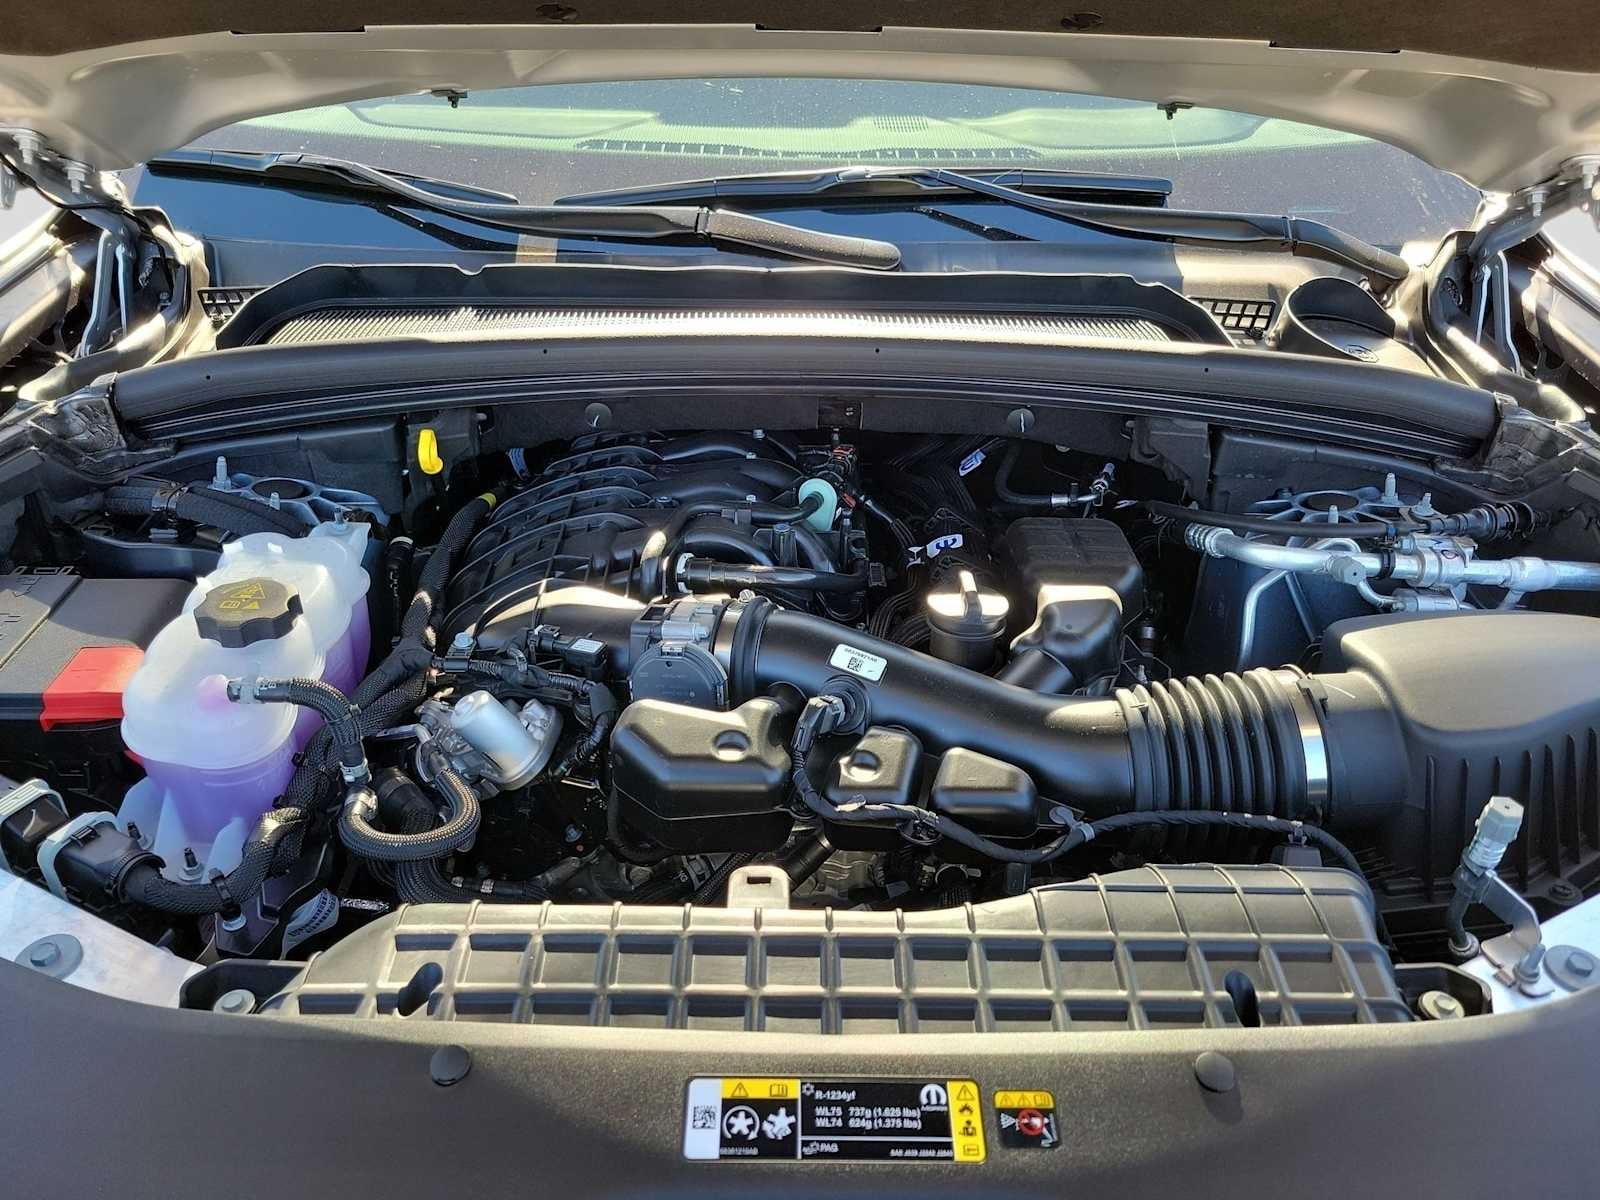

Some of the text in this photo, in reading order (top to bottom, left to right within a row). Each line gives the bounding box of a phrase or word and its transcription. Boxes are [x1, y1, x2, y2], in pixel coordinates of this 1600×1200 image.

[815, 1090, 856, 1102] R-1234yf
[815, 1106, 842, 1116] WL75
[815, 1117, 843, 1127] WL74
[820, 1143, 839, 1153] PAG
